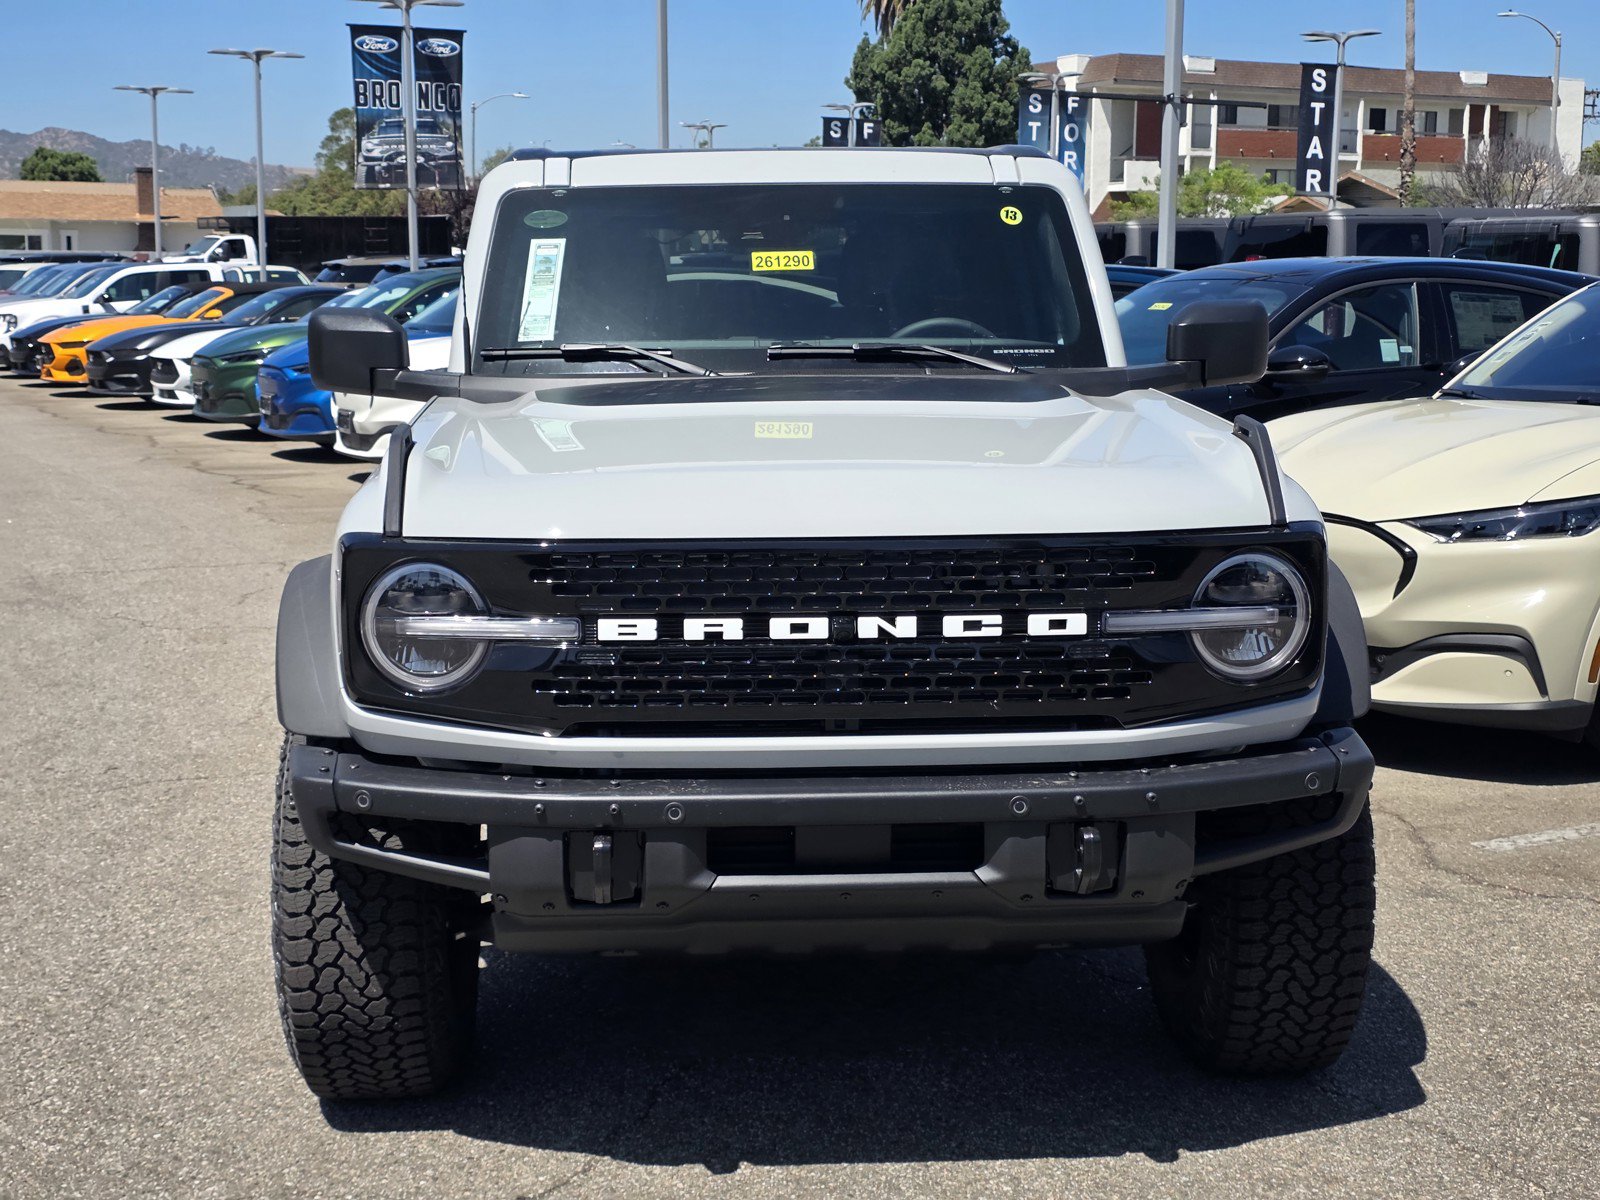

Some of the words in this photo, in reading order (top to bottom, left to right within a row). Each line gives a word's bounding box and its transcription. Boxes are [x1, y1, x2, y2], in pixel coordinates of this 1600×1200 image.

[1305, 68, 1327, 193] STAR
[1003, 209, 1017, 221] 13
[755, 255, 810, 268] 261290
[597, 613, 1088, 642] BRONCO
